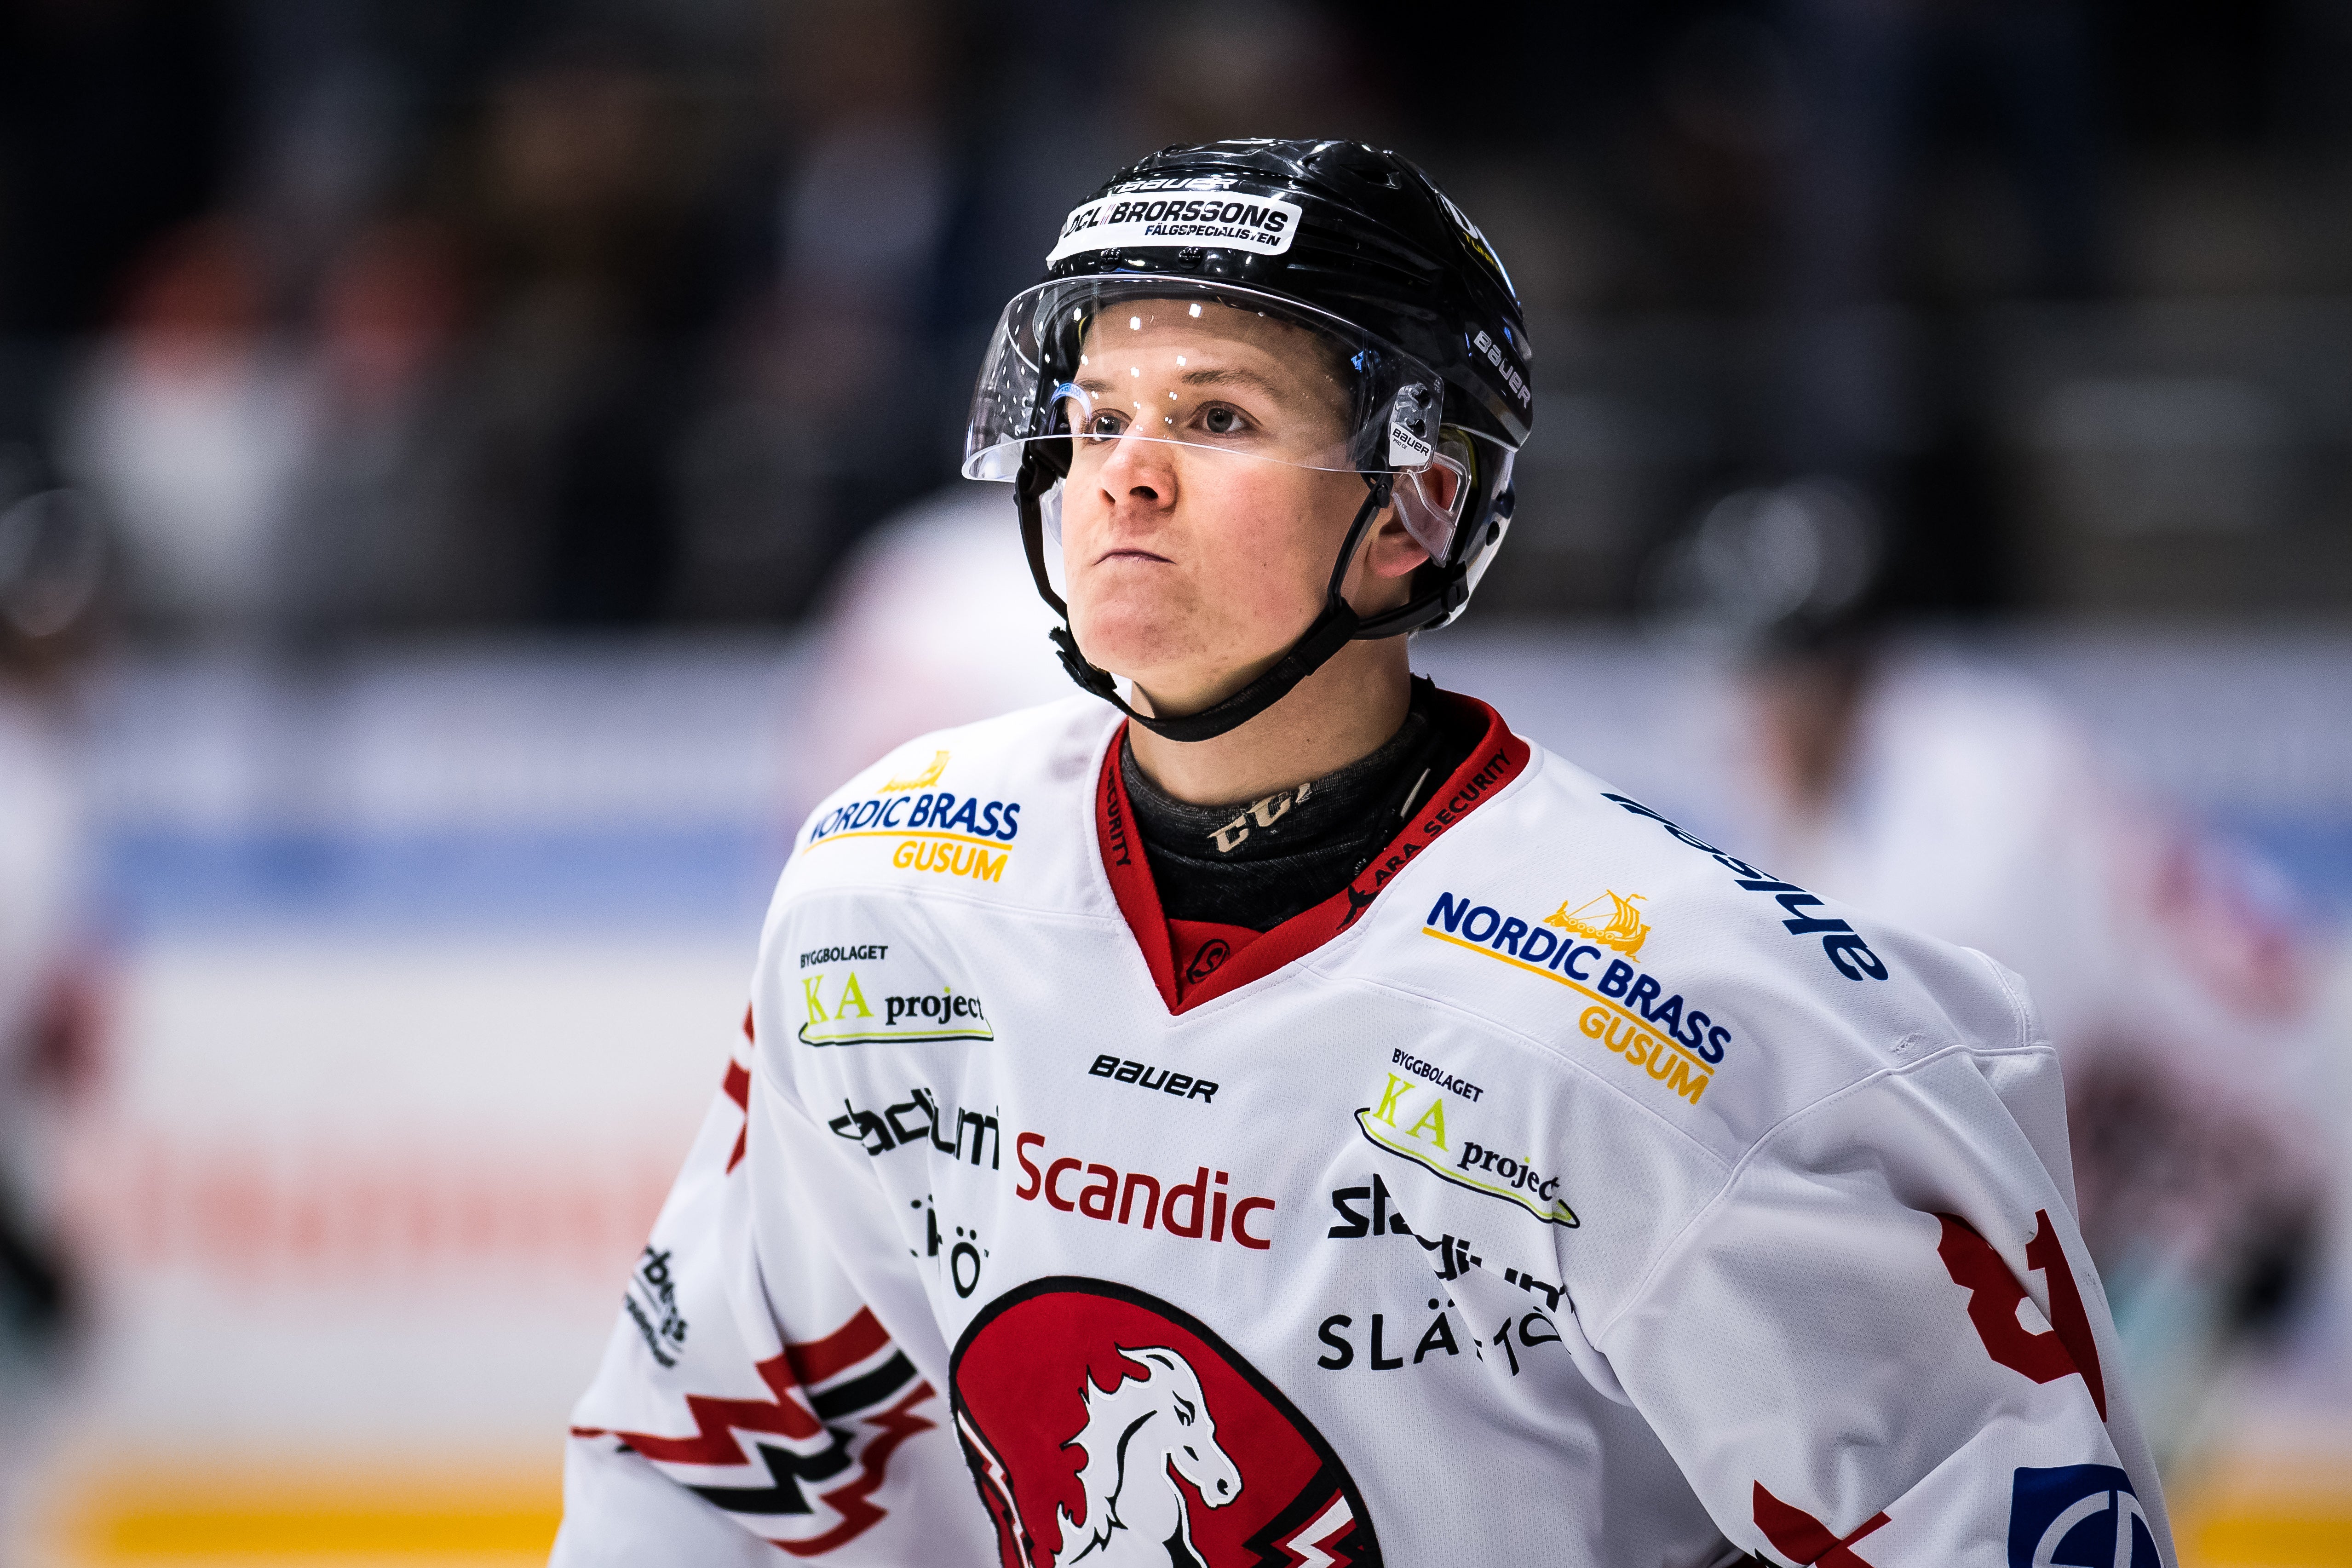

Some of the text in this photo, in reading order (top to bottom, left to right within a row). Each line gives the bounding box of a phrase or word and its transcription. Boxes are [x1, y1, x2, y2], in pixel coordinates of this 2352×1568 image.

[1108, 201, 1288, 232] BRORSSONS
[1473, 330, 1531, 409] BAUER
[1392, 428, 1429, 457] BAUER
[907, 793, 1021, 841] BRASS
[1207, 782, 1312, 853] CC
[1374, 748, 1511, 887] ARA SECURITY
[892, 840, 1009, 883] GUSUM
[800, 944, 889, 968] BYGGBOLAGET
[1426, 892, 1732, 1064] NORDIC BRASS
[1088, 1054, 1219, 1104] BAUER
[1392, 1047, 1484, 1103] BYGGBOLAGET
[1578, 1005, 1709, 1105] GUSUM
[1015, 1131, 1276, 1250] Scandic
